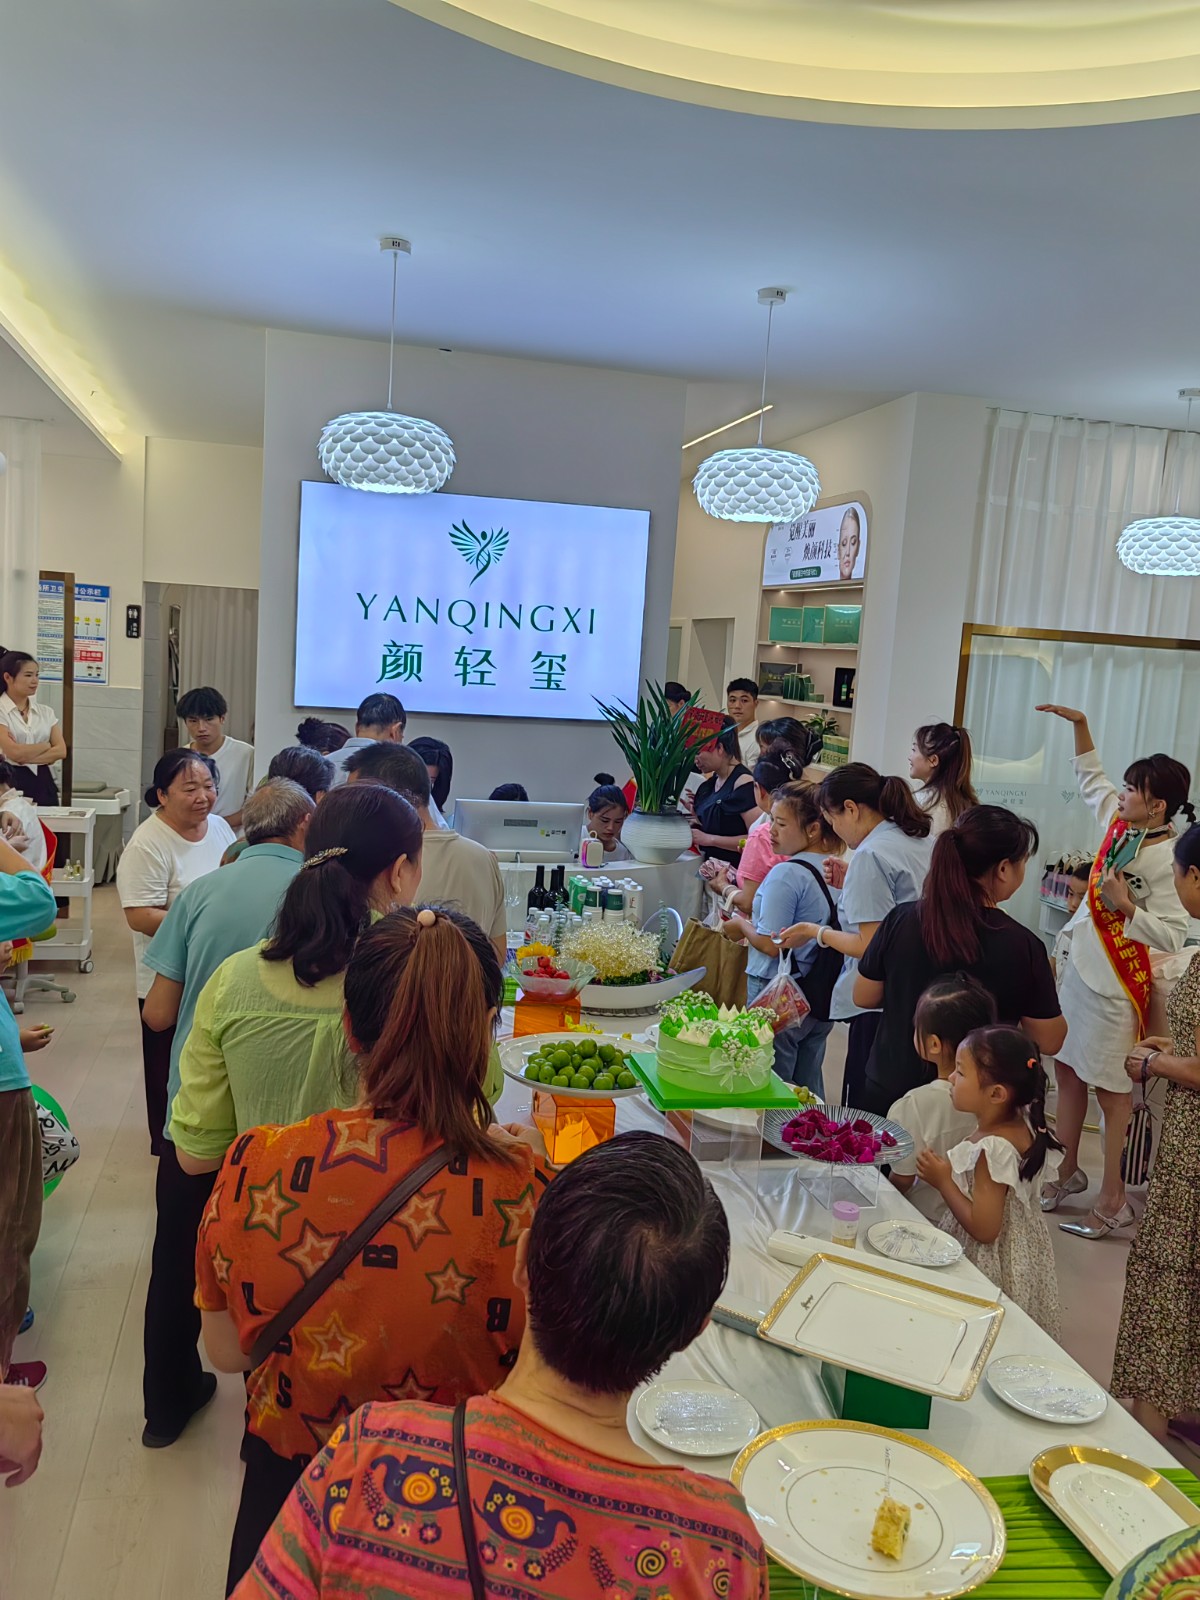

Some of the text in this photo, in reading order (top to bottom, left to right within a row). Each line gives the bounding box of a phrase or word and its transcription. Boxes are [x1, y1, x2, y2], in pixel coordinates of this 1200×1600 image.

[356, 592, 595, 635] YANQINGXI
[376, 639, 567, 691] 颜轻玺
[985, 789, 1027, 797] YANQINGXI
